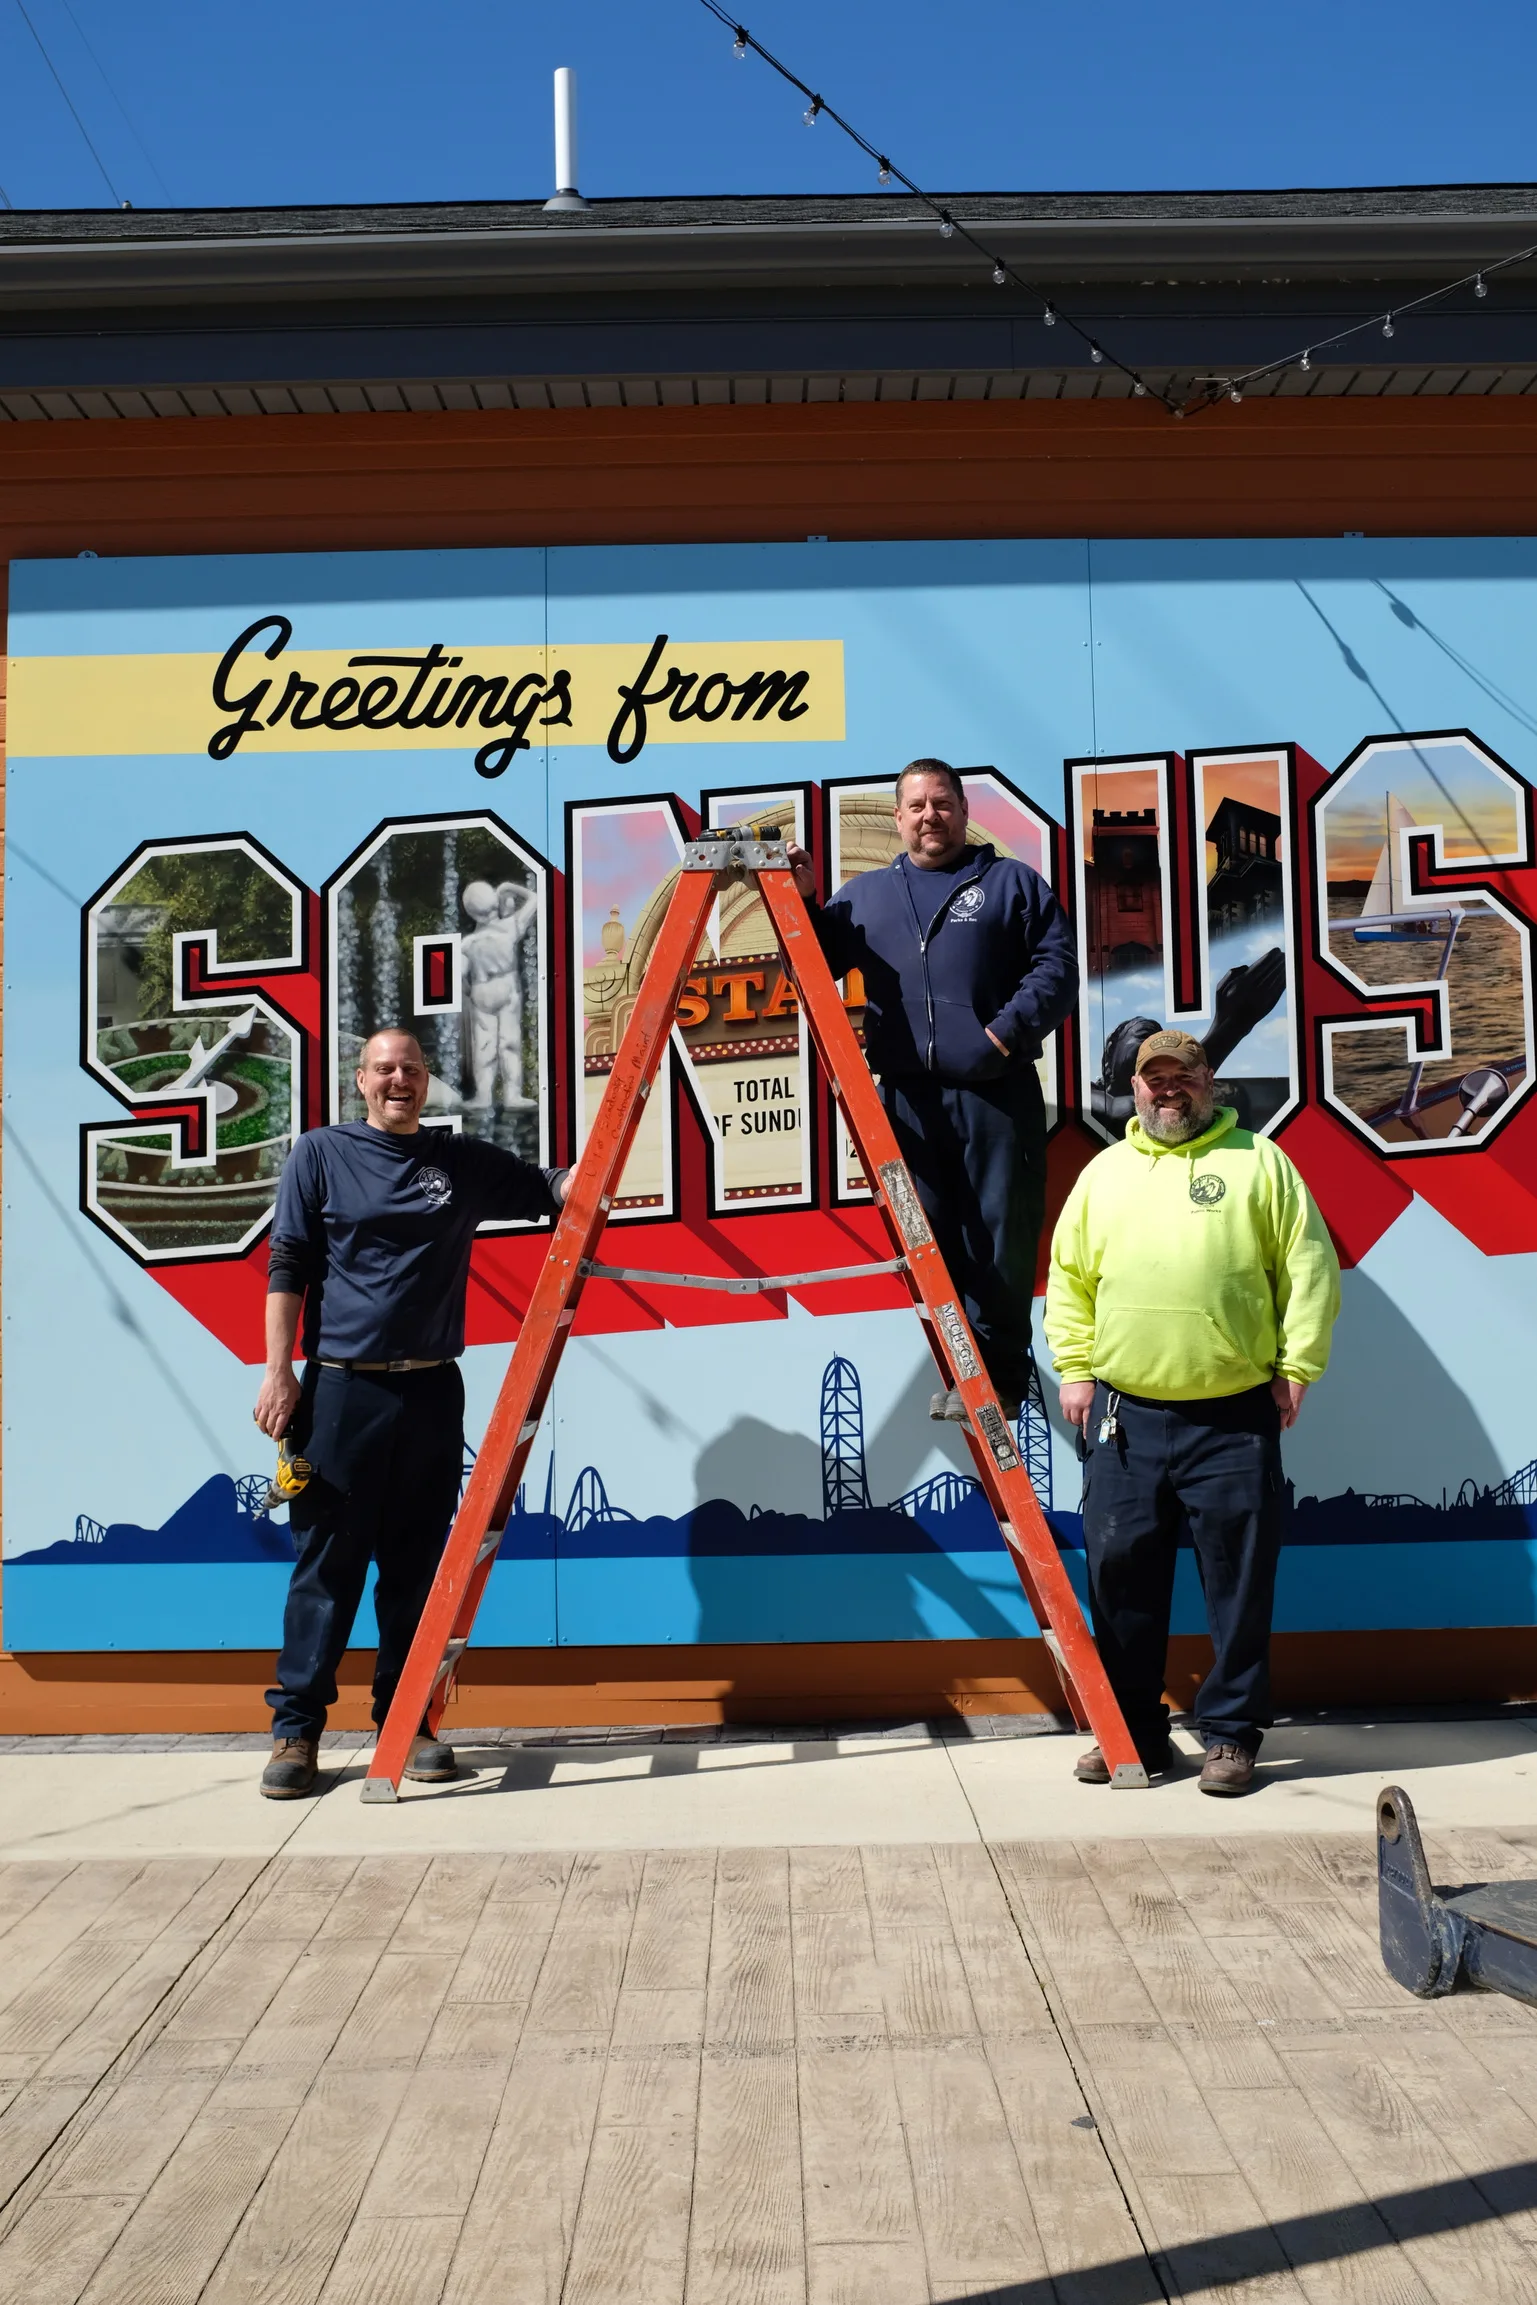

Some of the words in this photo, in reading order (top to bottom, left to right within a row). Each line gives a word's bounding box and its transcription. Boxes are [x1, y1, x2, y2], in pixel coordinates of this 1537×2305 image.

[207, 615, 573, 779] Greetings
[606, 634, 810, 764] from
[733, 1076, 795, 1103] TOTAL
[713, 1113, 733, 1137] F
